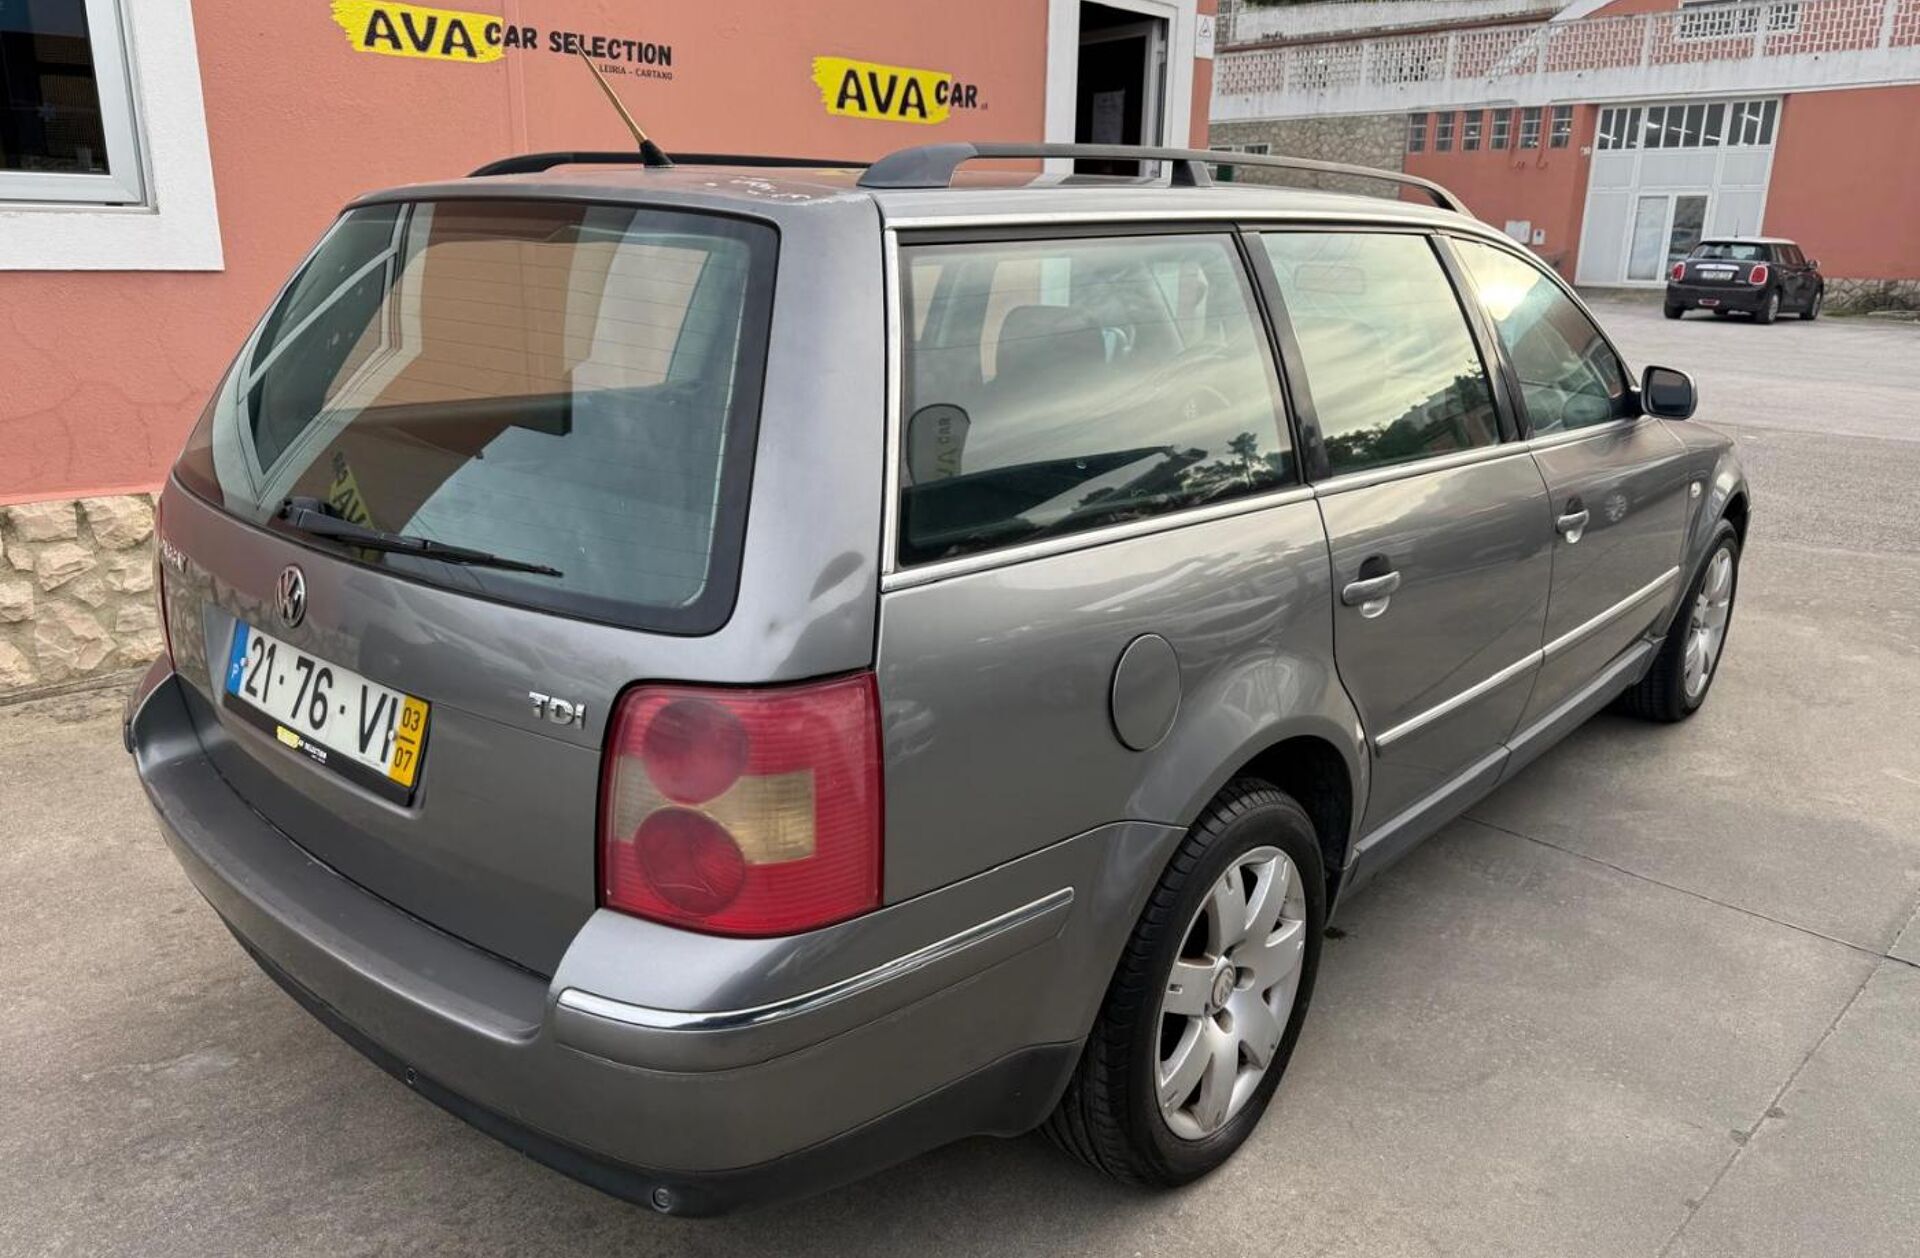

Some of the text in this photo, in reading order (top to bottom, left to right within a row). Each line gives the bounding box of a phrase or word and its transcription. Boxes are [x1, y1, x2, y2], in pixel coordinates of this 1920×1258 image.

[364, 9, 672, 66] AVA CAR SELECTION
[836, 69, 978, 118] AVA CAR
[402, 707, 421, 732] 03
[528, 691, 586, 729] TDI
[394, 747, 413, 771] 07
